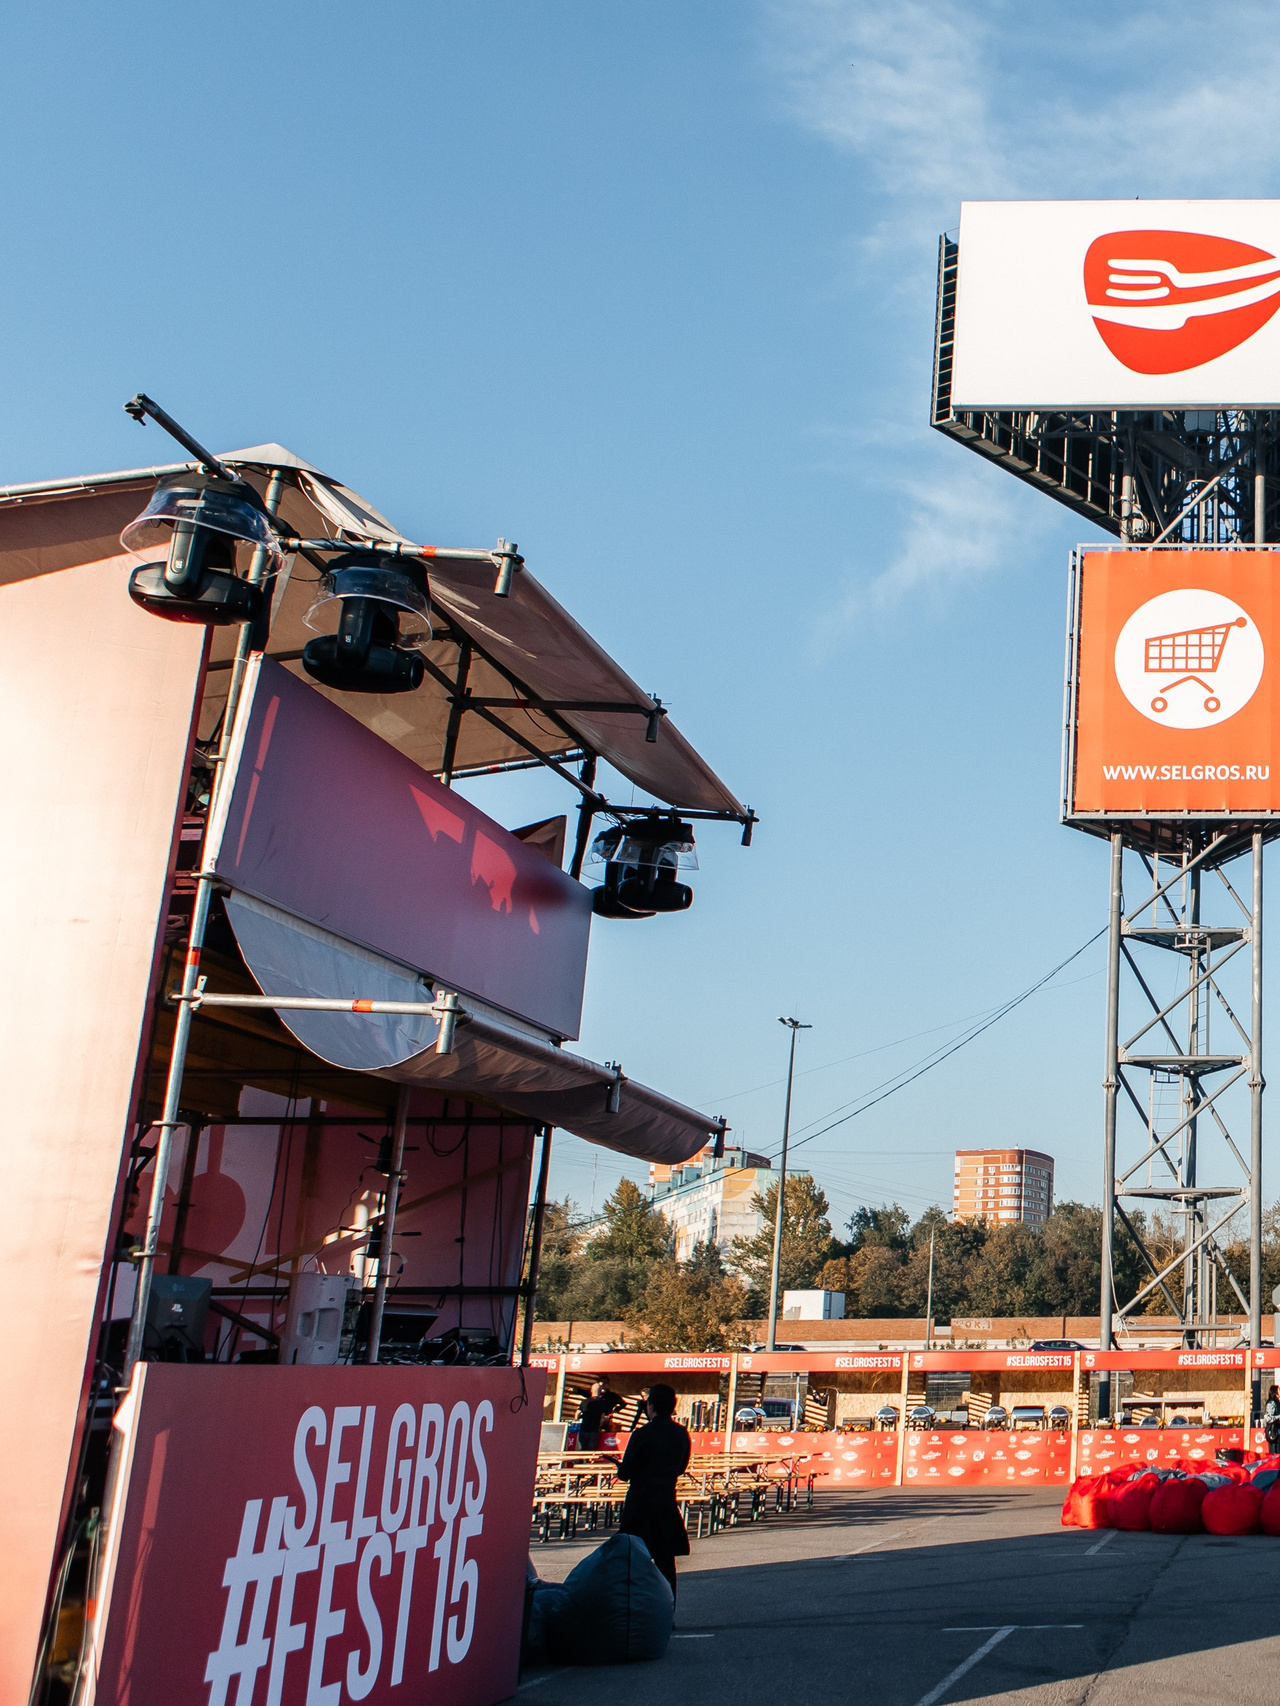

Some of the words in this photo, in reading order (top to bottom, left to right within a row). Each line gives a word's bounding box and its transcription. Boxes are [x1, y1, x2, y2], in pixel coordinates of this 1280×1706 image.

[1102, 765, 1270, 781] WWW.SELGROS.RU
[664, 1356, 730, 1368] #SELGROSFEST15
[835, 1356, 901, 1368] #SELGROSFEST15
[1006, 1355, 1072, 1367] #SELGROSFEST15
[1178, 1354, 1243, 1366] #SELGROSFEST15
[287, 1399, 494, 1549] SELGROS
